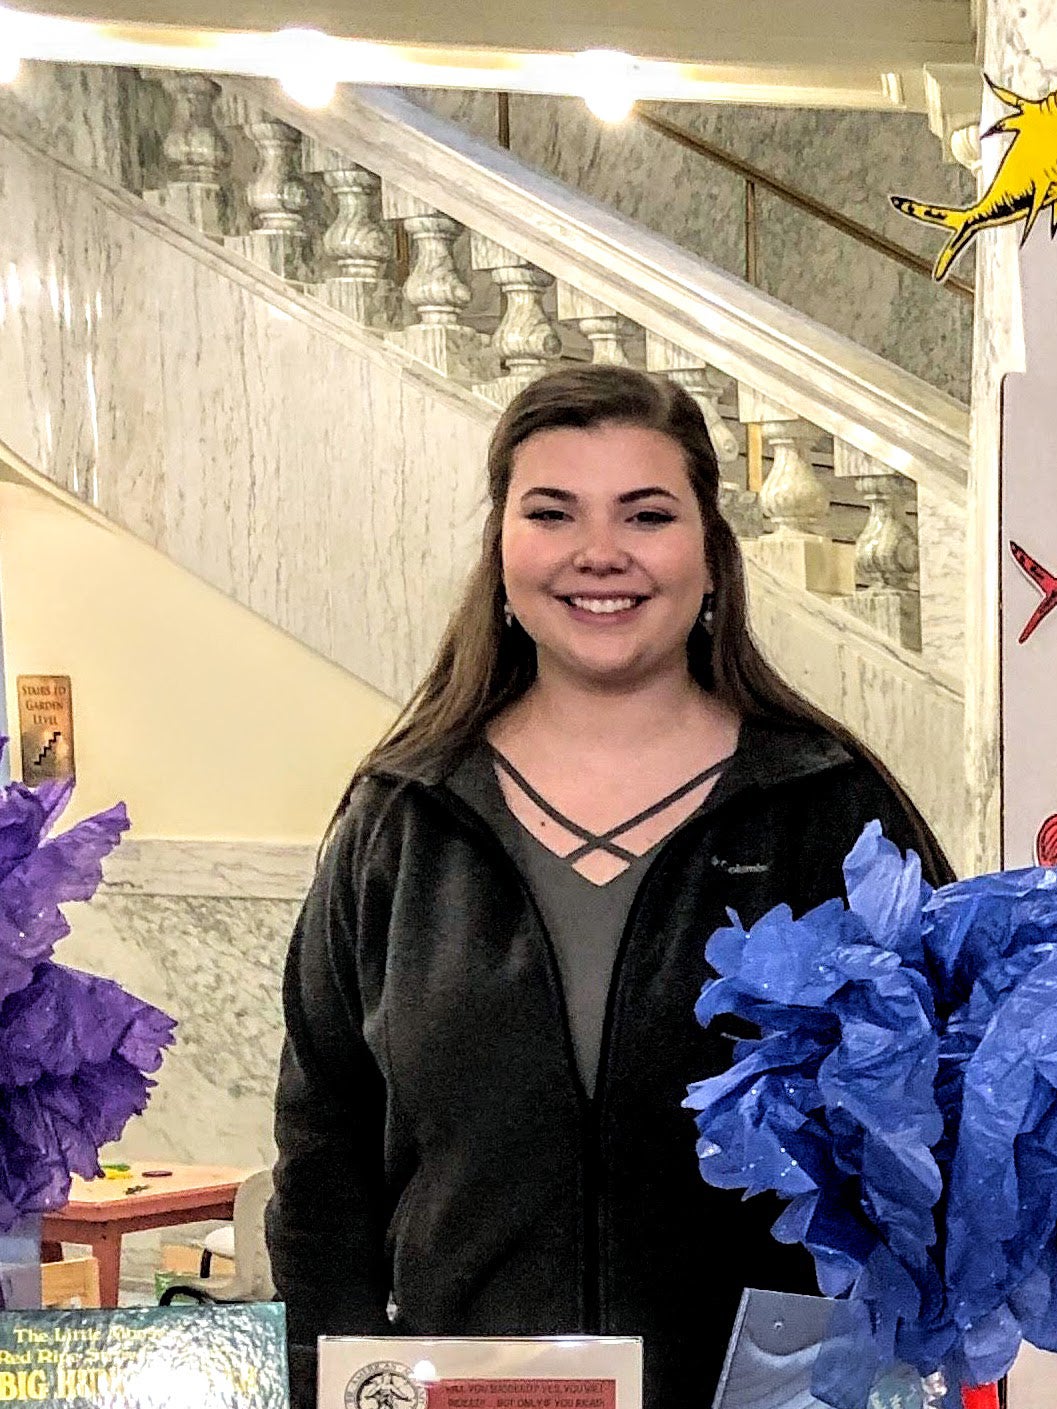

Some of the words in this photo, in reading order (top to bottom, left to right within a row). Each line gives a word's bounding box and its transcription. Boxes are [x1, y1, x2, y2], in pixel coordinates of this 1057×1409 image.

[26, 700, 63, 711] GARDEN
[33, 714, 58, 725] LEVEL
[13, 1327, 50, 1344] The
[0, 1369, 48, 1401] BIG
